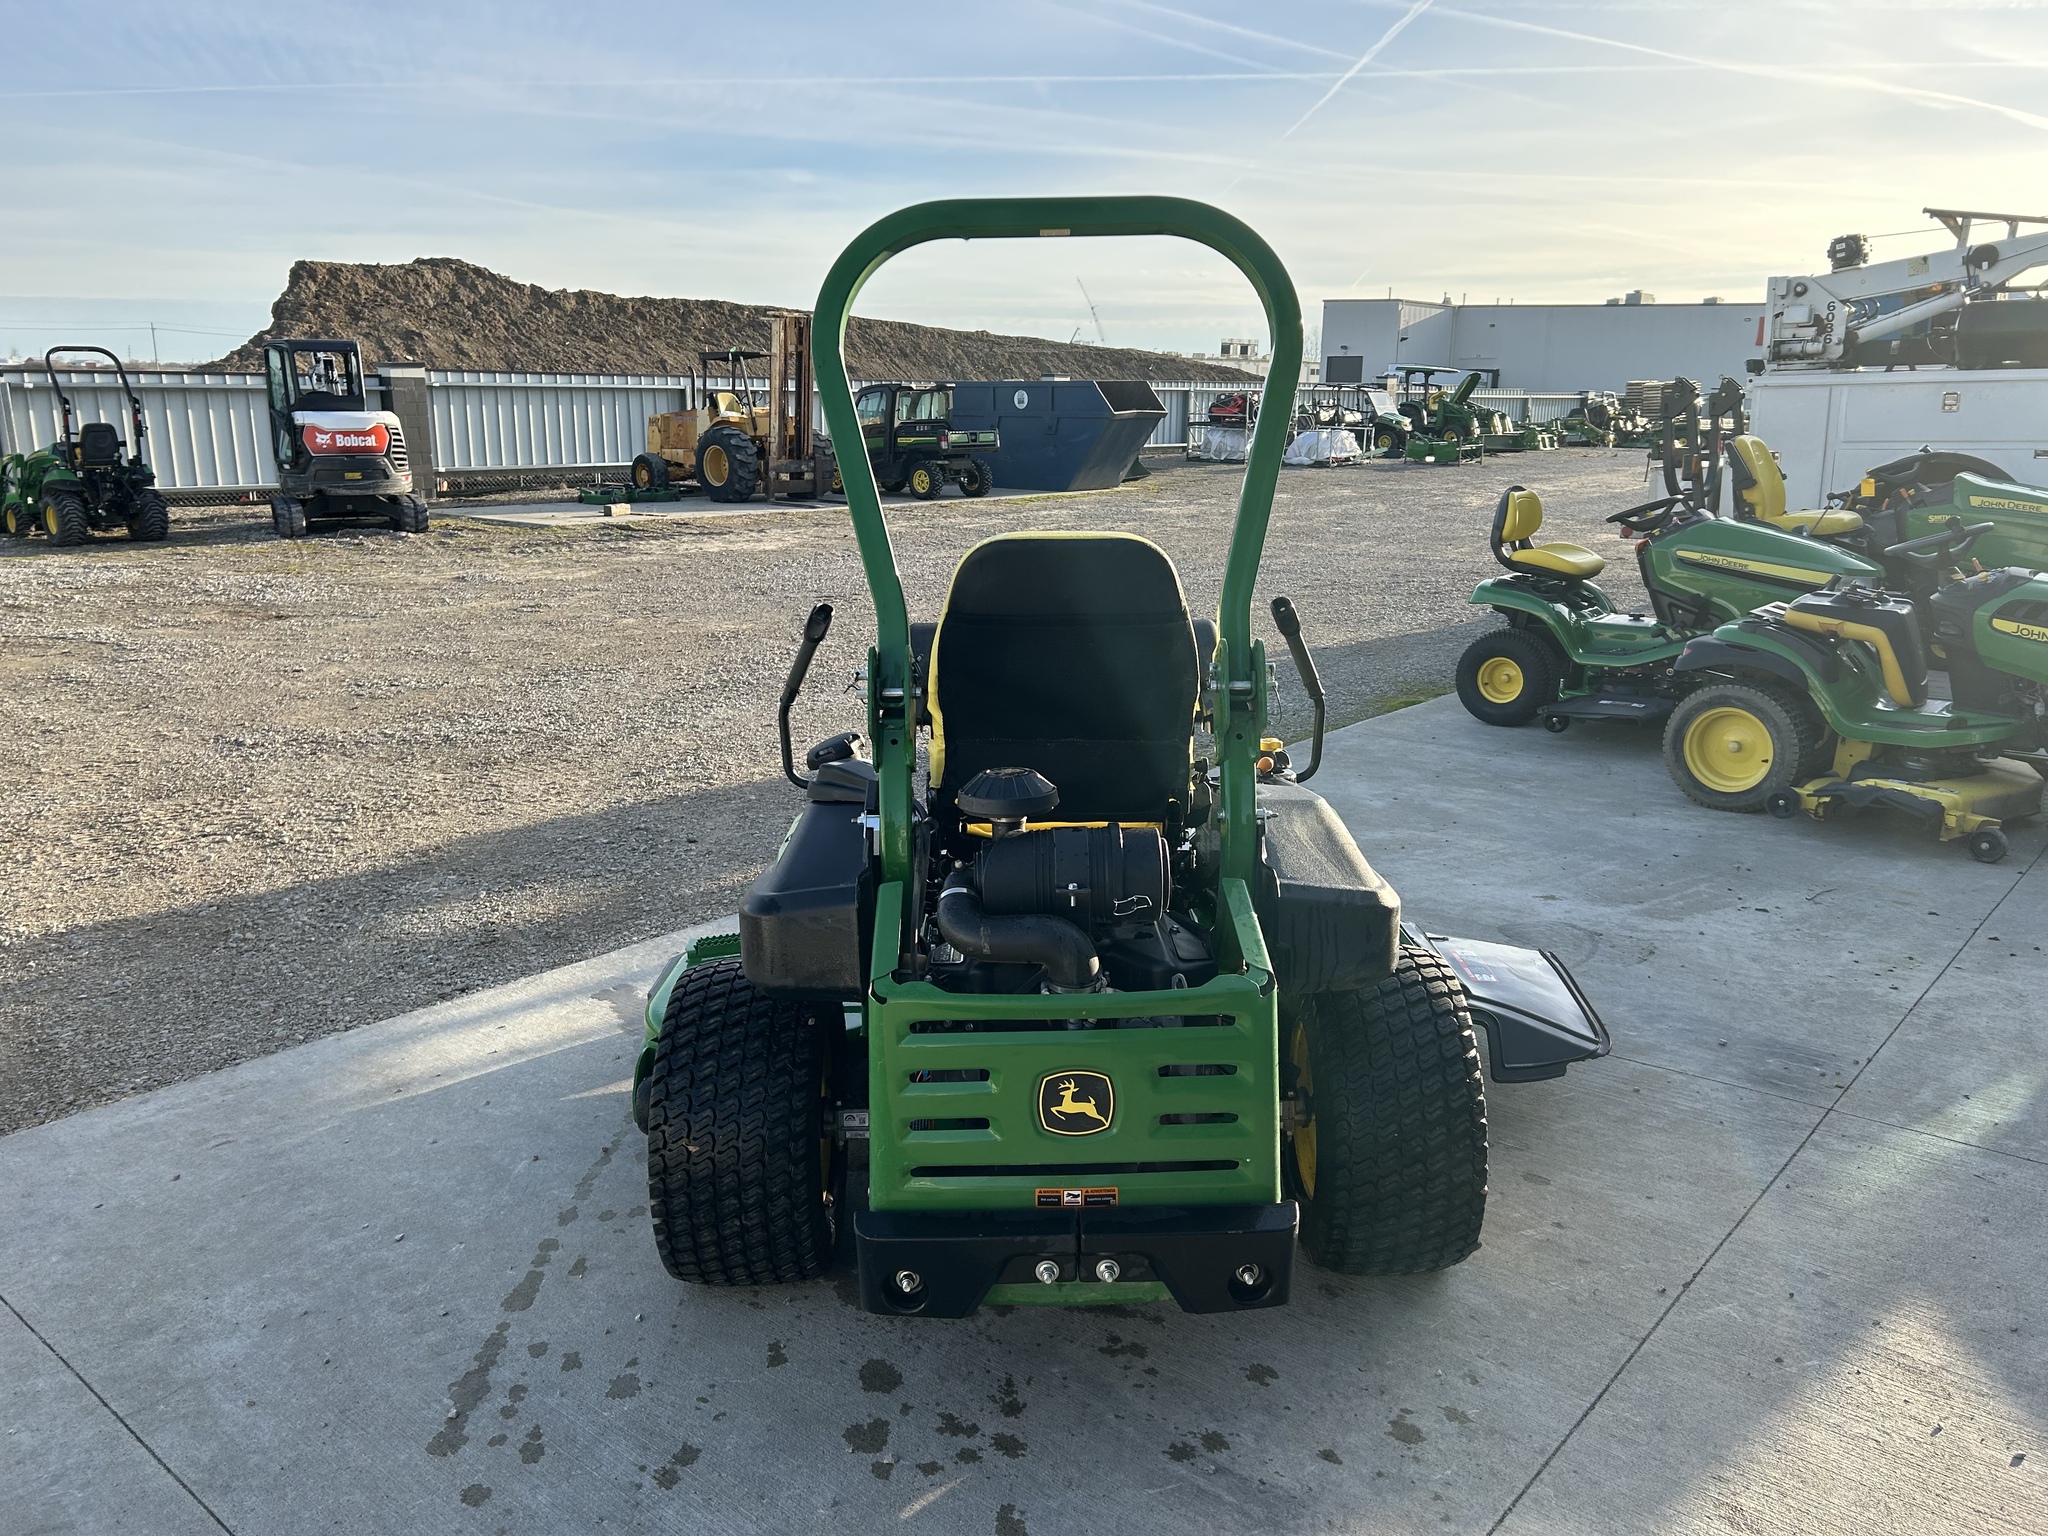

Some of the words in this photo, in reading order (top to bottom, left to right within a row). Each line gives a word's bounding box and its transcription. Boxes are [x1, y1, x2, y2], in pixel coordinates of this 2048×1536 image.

[335, 434, 377, 447] Bobcat
[1977, 499, 2006, 509] JOHN
[2007, 501, 2042, 513] DEERE
[1698, 554, 1720, 565] JOHN
[1721, 558, 1749, 570] DEERE
